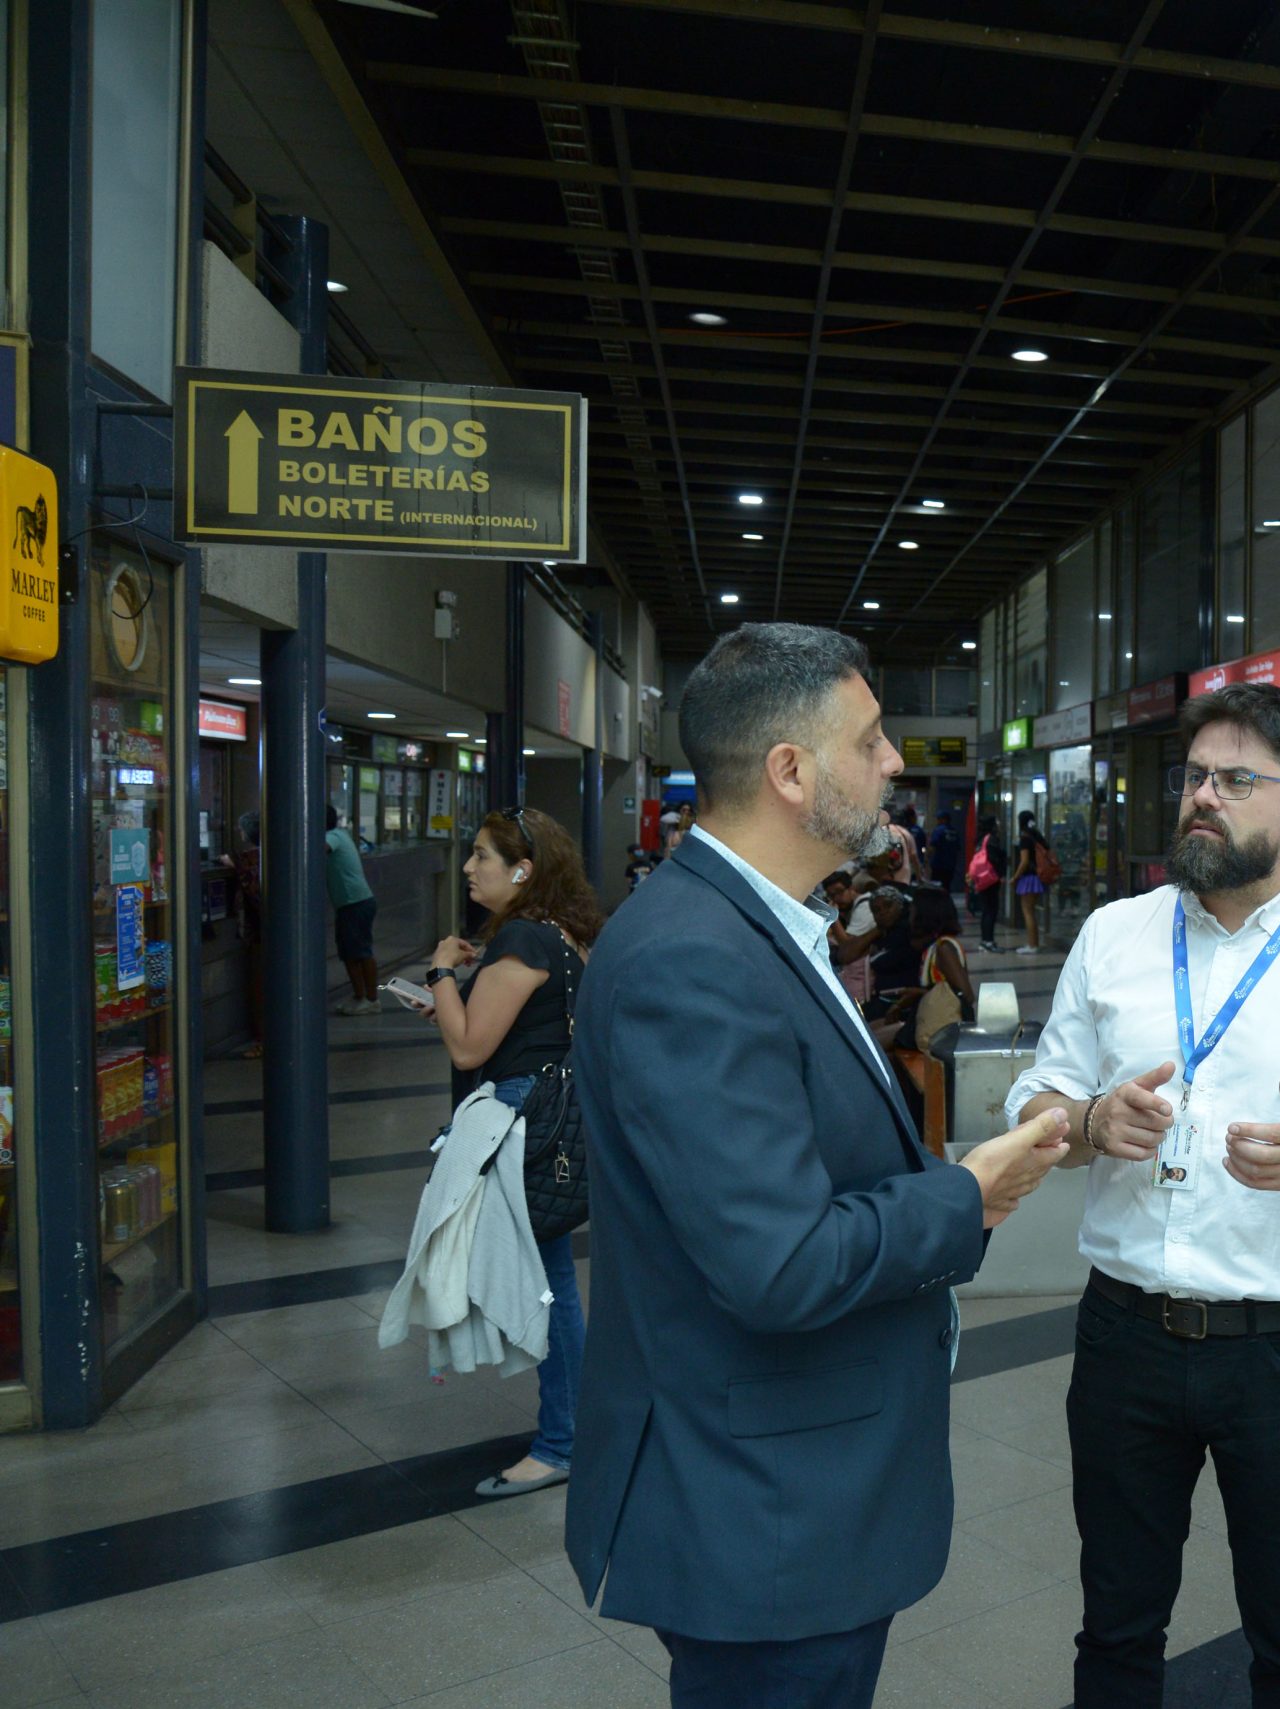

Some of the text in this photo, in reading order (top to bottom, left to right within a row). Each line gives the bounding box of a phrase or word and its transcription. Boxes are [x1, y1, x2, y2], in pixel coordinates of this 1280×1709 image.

[277, 406, 488, 458] BAÑOS
[278, 459, 490, 494] BOLETERÍAS
[278, 494, 539, 532] NORTE (INTERNACIONAL)
[11, 567, 56, 605] MARLEY
[22, 604, 46, 622] COFFEE
